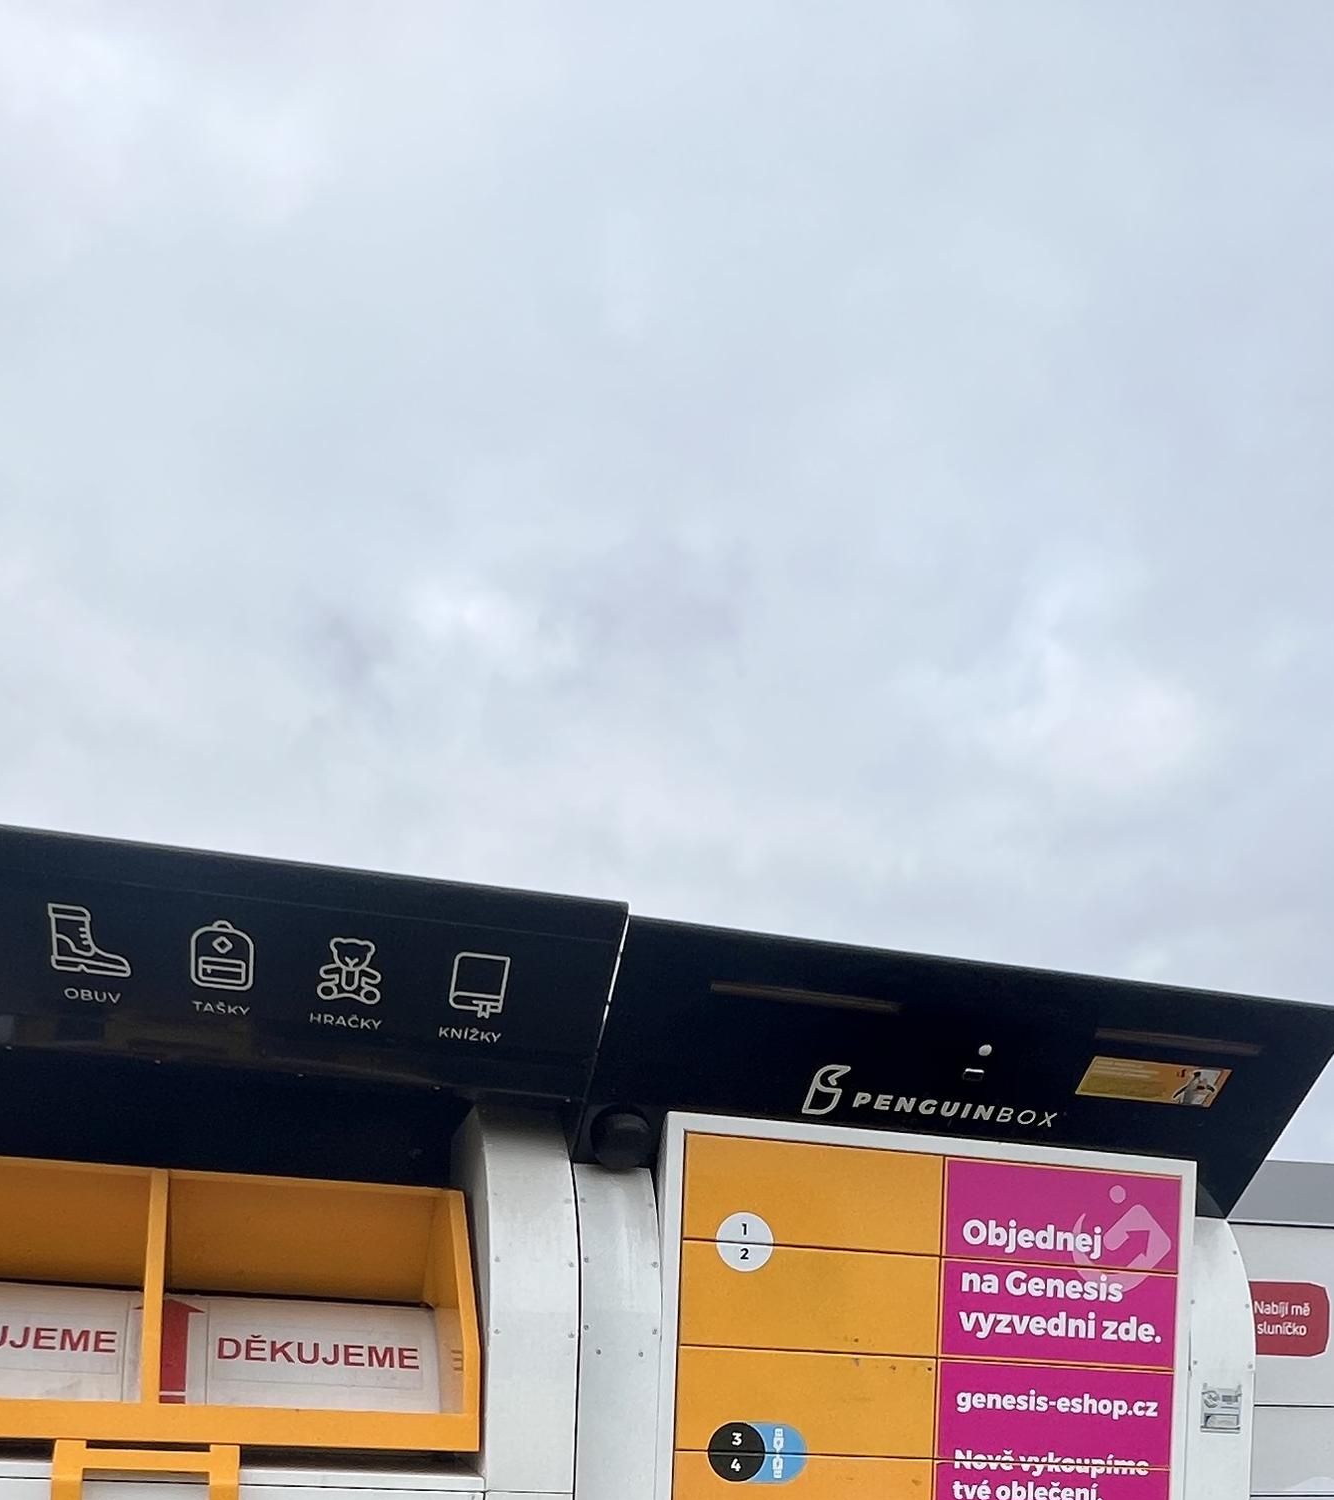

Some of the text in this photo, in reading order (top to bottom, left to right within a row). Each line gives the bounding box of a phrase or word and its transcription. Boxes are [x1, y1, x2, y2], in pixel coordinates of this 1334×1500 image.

[64, 987, 122, 1004] OBUV
[192, 1000, 250, 1017] TAŠKY
[310, 1012, 381, 1030] HRAČKY
[439, 1026, 502, 1043] KNÍŽKY
[852, 1092, 1058, 1127] PENGUINBOX
[740, 1222, 748, 1236] 1
[962, 1219, 1103, 1259] Objednej
[739, 1246, 750, 1260] 2
[961, 1271, 1123, 1302] na Genesis
[1291, 1303, 1311, 1316] mě
[959, 1310, 1162, 1344] vyzvedni zde.
[1257, 1321, 1307, 1336] sluníčko
[217, 1335, 421, 1370] DĚKUJEME
[956, 1390, 1158, 1420] genesis-eshop.cz
[731, 1431, 743, 1446] 3
[730, 1458, 742, 1472] 4
[953, 1480, 991, 1500] tvé
